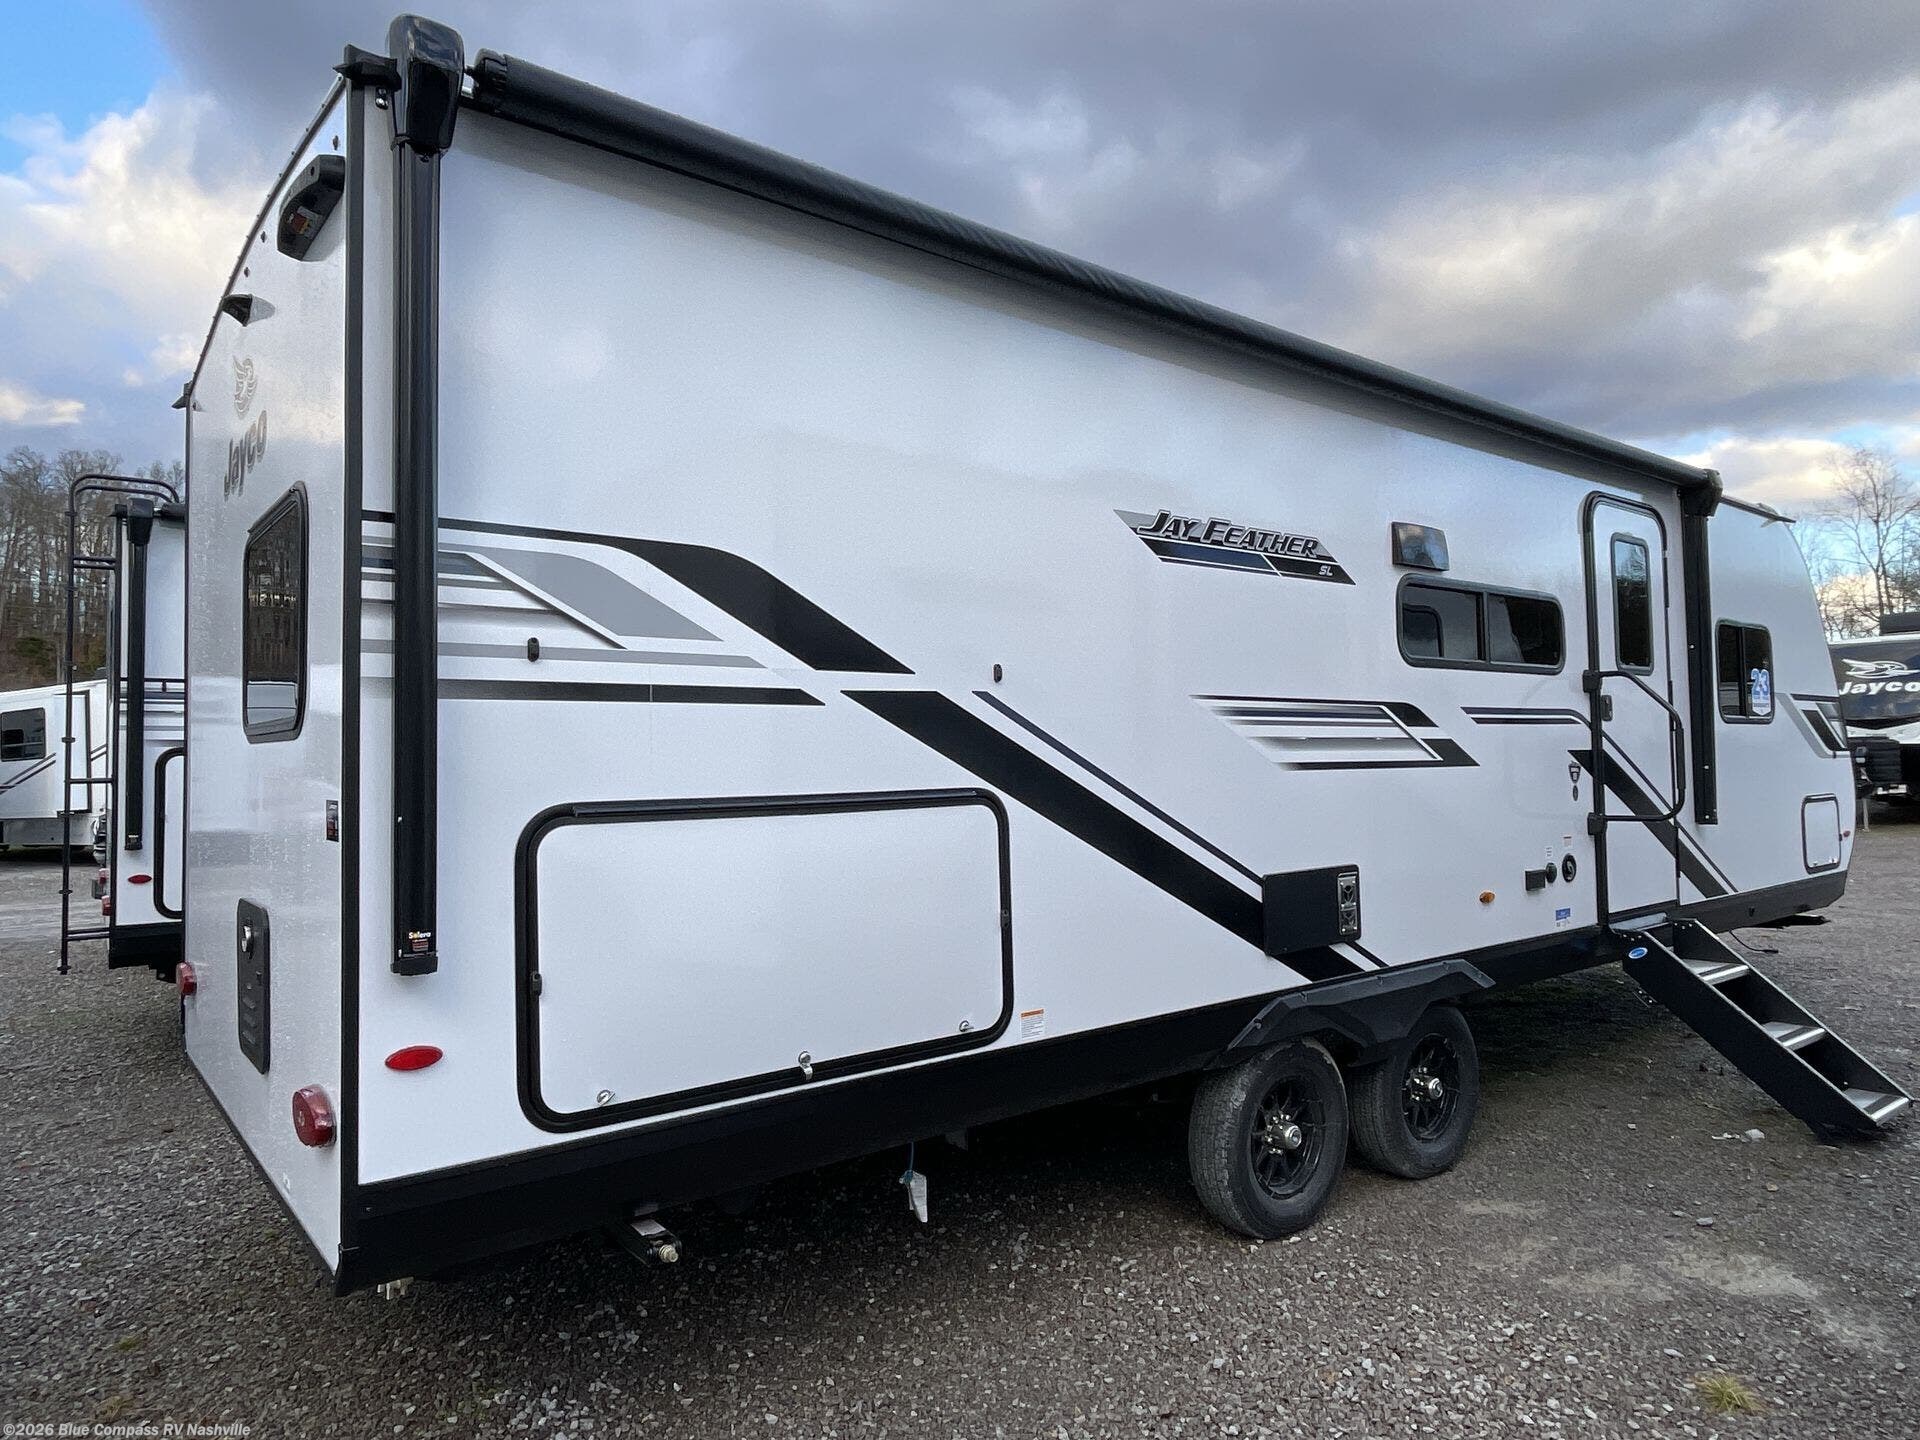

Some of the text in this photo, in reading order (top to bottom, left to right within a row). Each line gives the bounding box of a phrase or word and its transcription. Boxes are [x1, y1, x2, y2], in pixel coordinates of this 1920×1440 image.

[223, 409, 268, 500] Jayco
[1137, 509, 1319, 559] JAY FEATHER
[1318, 565, 1334, 577] SL
[1839, 681, 1920, 695] Jayco
[408, 931, 432, 939] Solera
